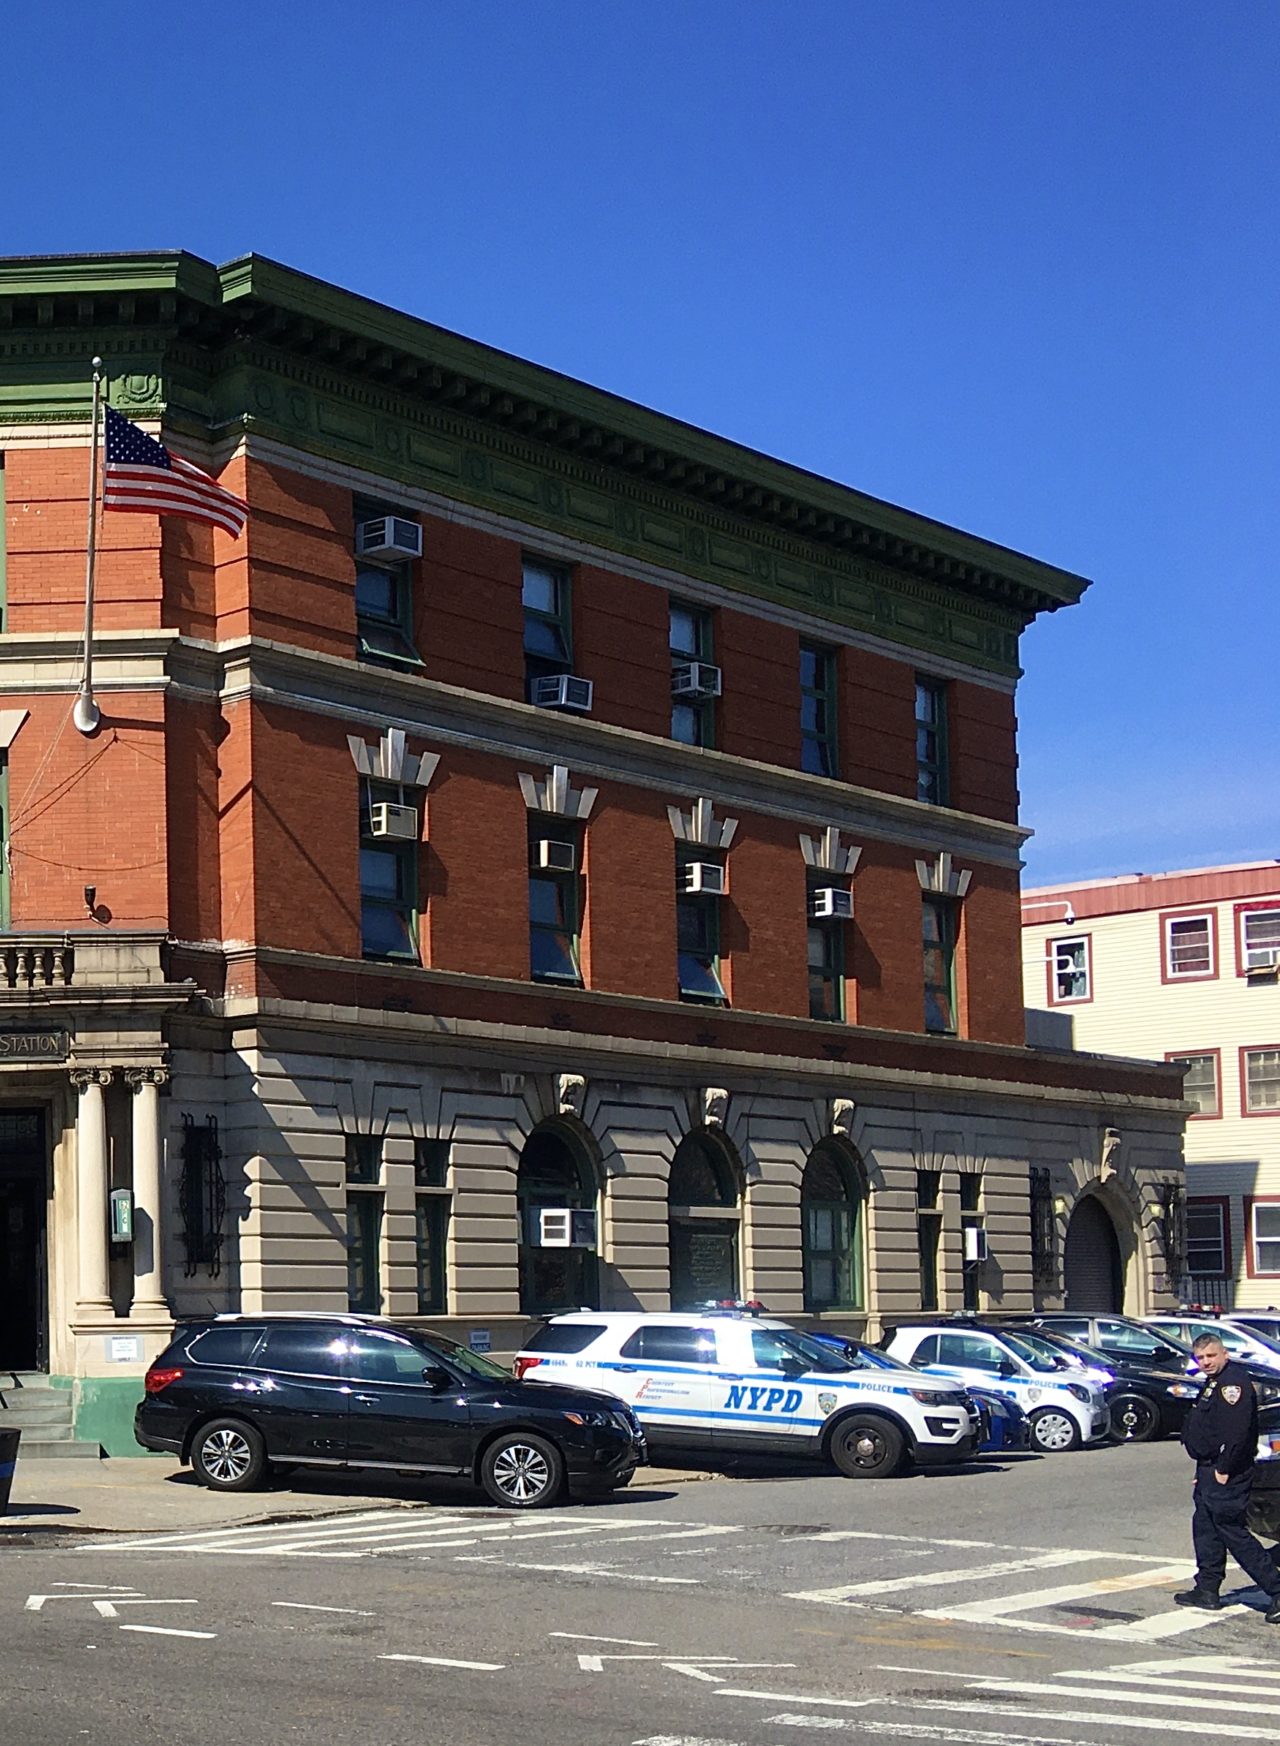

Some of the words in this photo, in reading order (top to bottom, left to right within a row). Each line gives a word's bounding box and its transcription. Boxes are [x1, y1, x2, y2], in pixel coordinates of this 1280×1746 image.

[0, 1035, 59, 1052] STATION
[861, 1382, 893, 1393] POLICE
[1029, 1379, 1057, 1390] POLICE
[724, 1385, 804, 1413] NYPD
